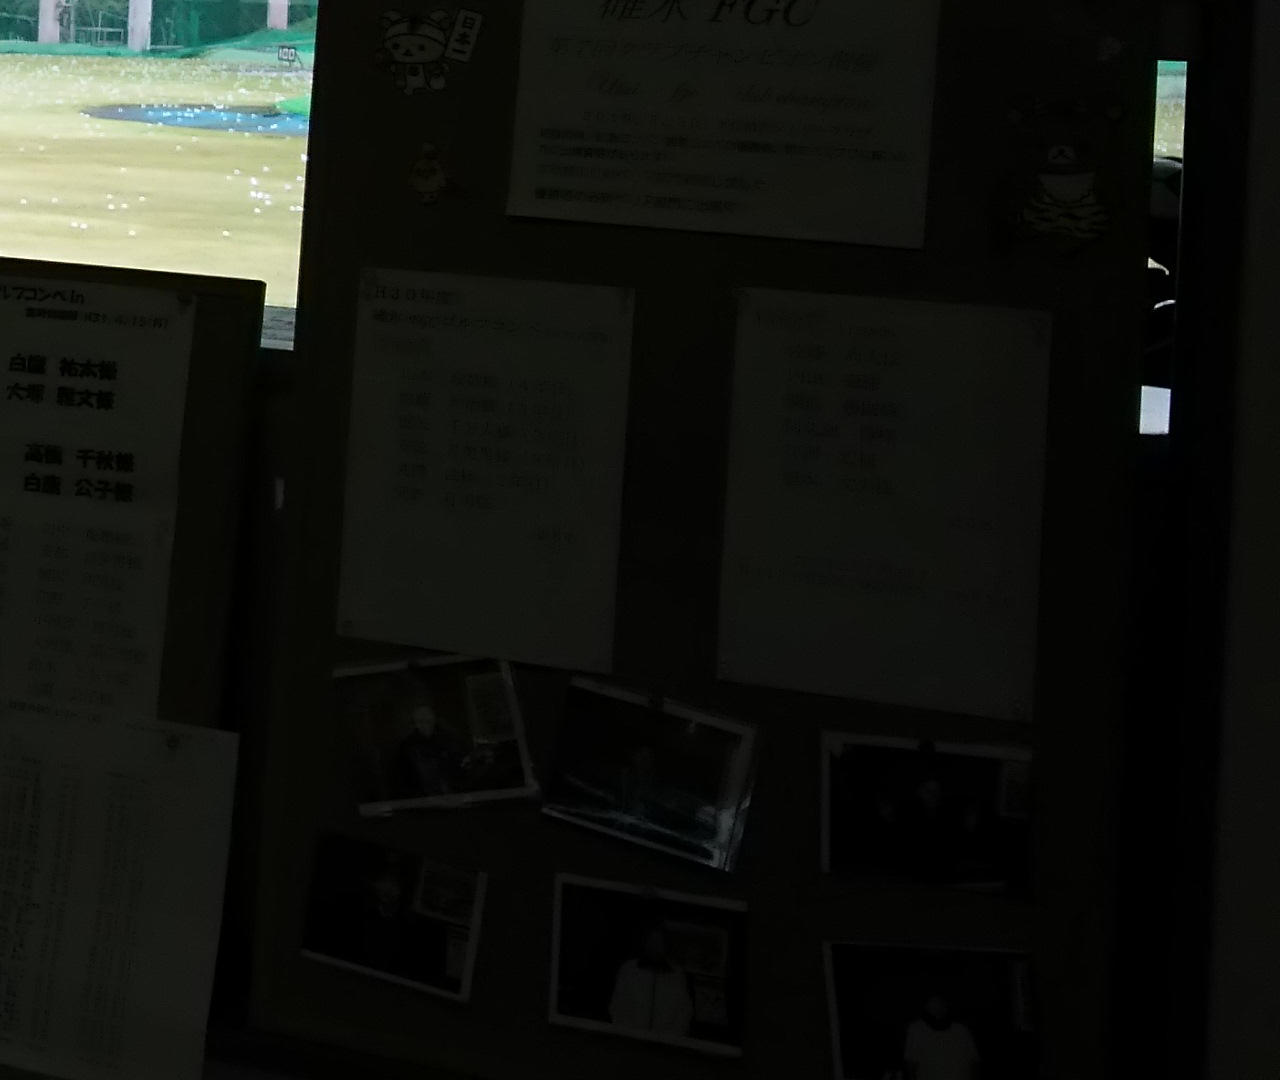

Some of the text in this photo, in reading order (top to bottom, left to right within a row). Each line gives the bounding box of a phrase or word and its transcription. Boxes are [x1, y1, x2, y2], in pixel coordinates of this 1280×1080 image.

[452, 16, 475, 54] 日本一
[279, 48, 295, 60] 100
